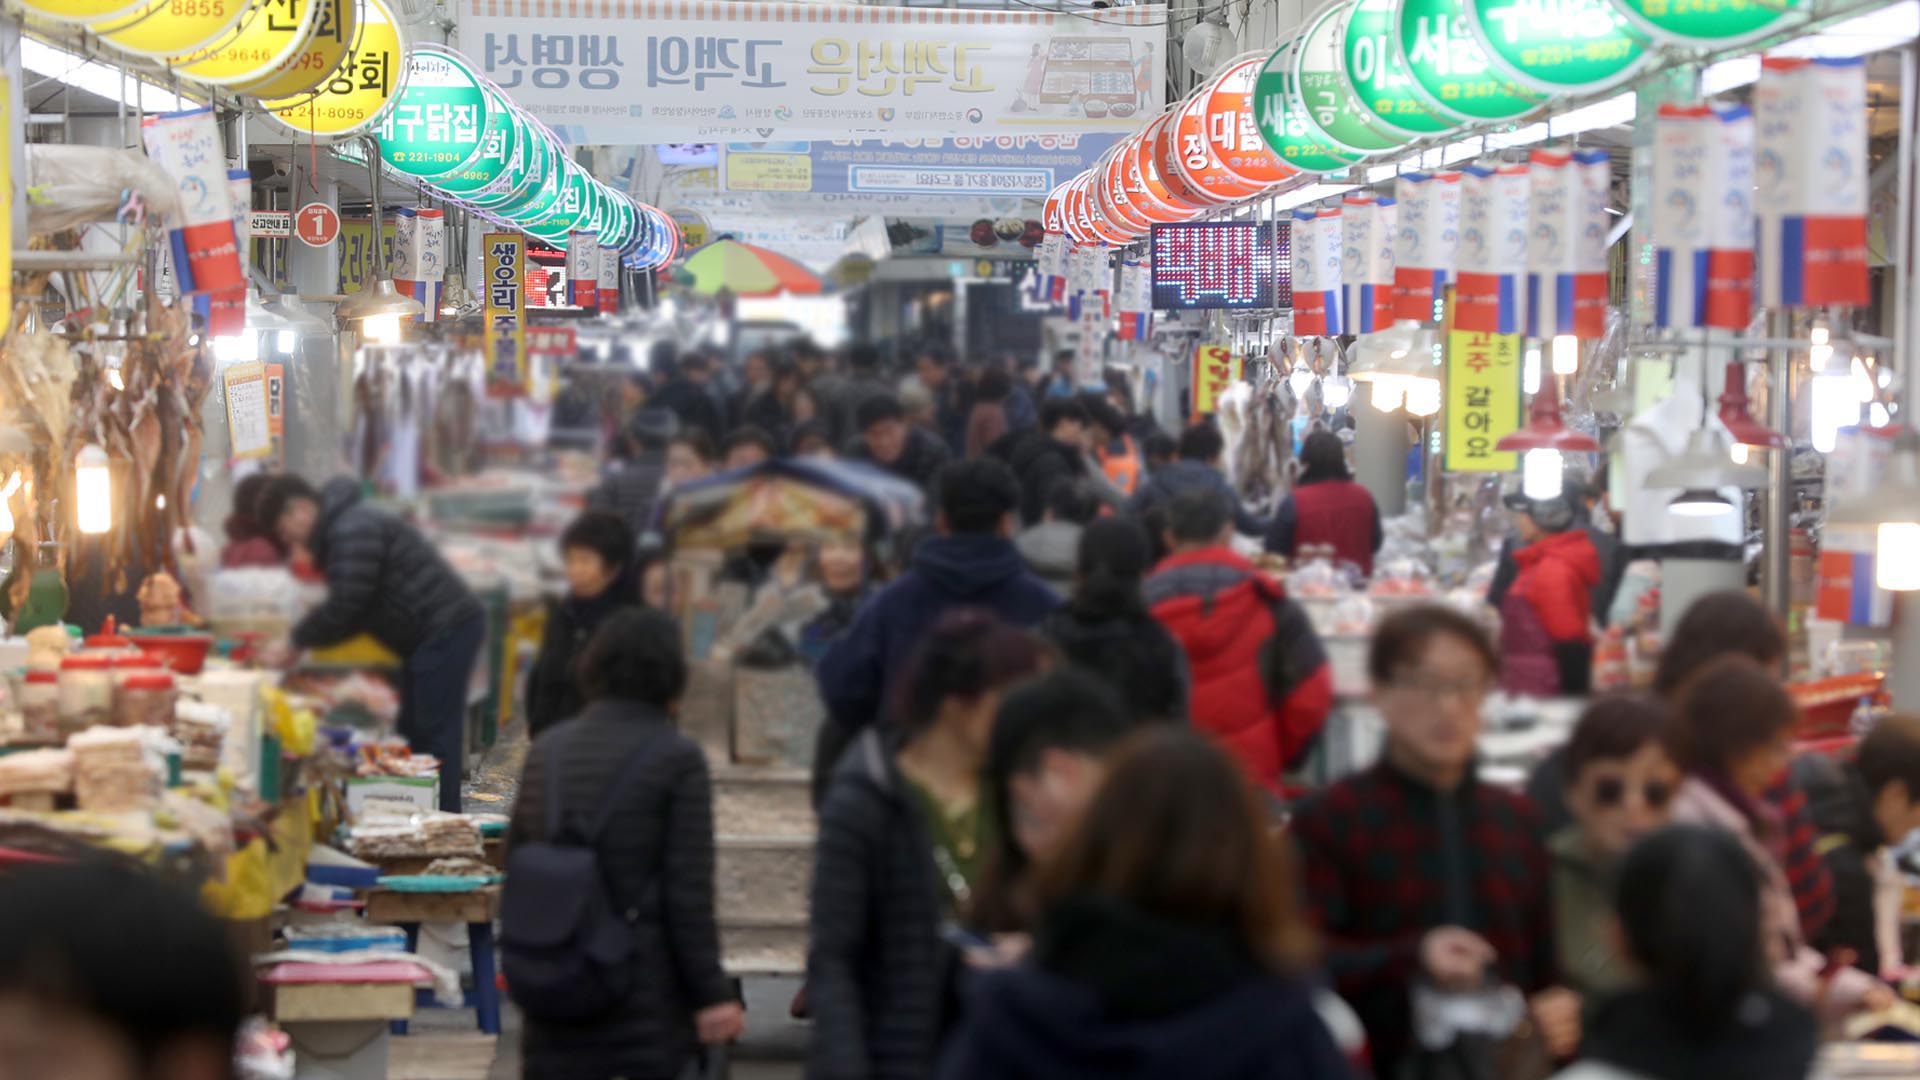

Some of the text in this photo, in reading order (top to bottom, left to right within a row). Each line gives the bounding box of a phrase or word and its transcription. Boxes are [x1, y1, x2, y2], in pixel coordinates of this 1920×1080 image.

[298, 106, 364, 120] 241-8095
[408, 152, 461, 163] 221-1904
[312, 214, 323, 236] 1
[1465, 386, 1493, 458] 갈아요
